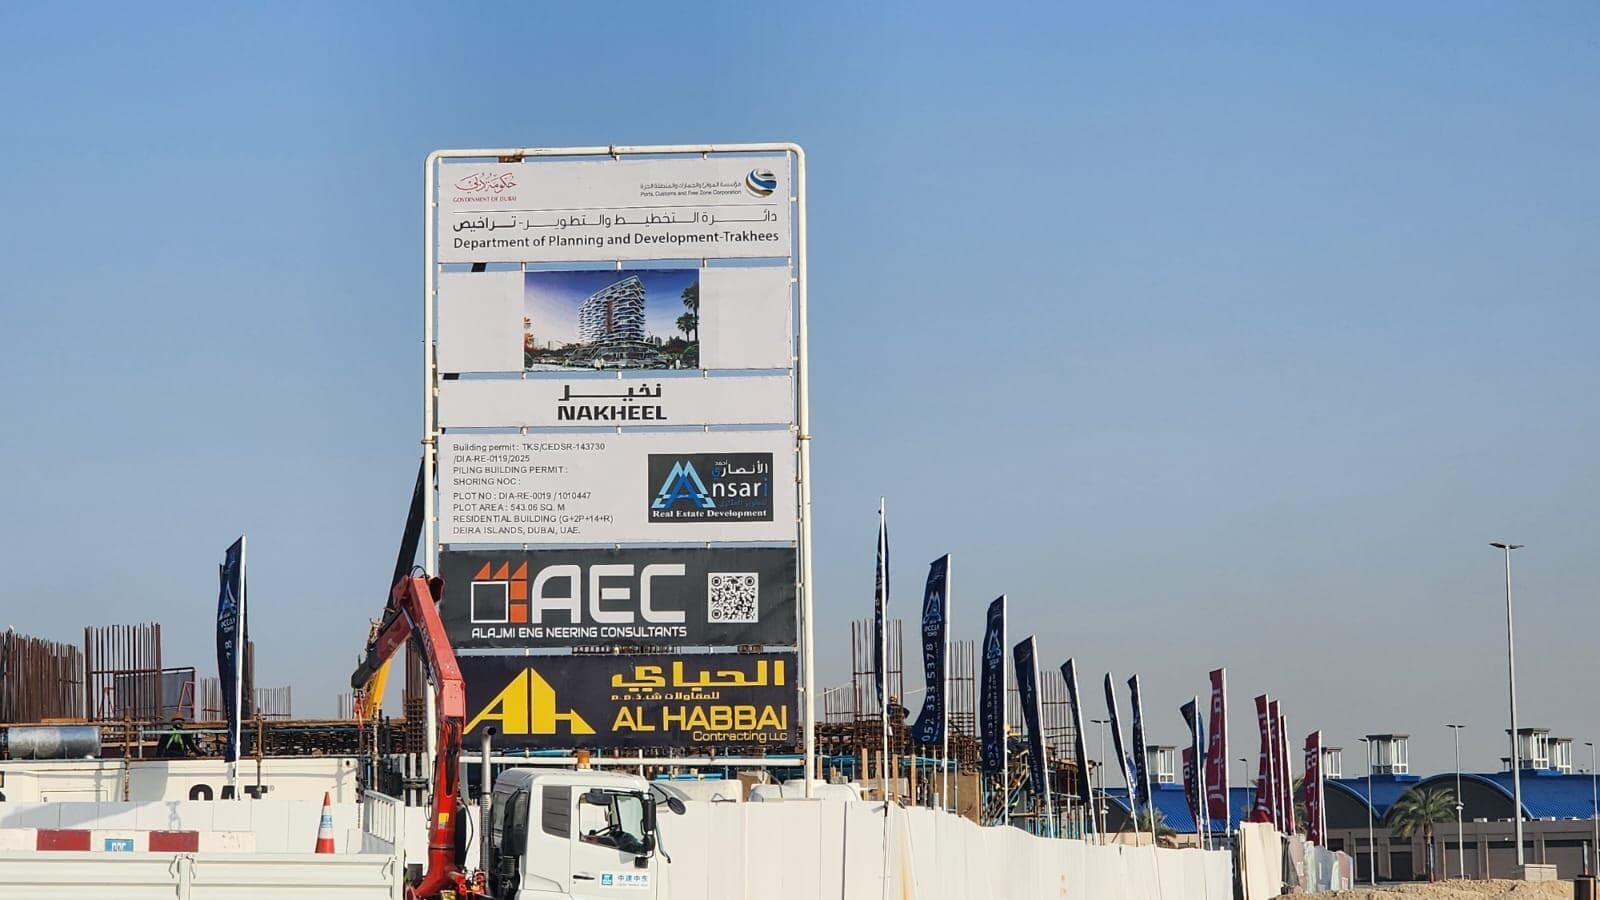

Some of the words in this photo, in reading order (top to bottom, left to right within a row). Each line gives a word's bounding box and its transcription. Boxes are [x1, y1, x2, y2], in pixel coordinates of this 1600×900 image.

[655, 190, 677, 198] Customs
[713, 188, 742, 197] Corporation
[454, 236, 530, 250] Department
[533, 235, 546, 247] of
[549, 234, 604, 248] Planning
[607, 233, 631, 245] and
[634, 230, 779, 246] Development-Trakhees
[558, 383, 661, 402] نخيل
[557, 405, 667, 420] NAKHEEL
[453, 443, 486, 453] Building
[522, 442, 606, 453] TKS/CEDSR-143730
[453, 454, 530, 464] /DIA-RE-0119/2025
[453, 466, 483, 474] PILING
[485, 466, 527, 474] BUILDING
[453, 478, 495, 486] SHORING
[453, 492, 476, 500] PLOT
[499, 492, 551, 500] DIA-RE-0019
[558, 492, 592, 500] 1010447
[453, 504, 476, 512] PLOT
[510, 503, 538, 512] 543.06
[557, 503, 565, 511] M
[453, 515, 512, 523] RESIDENTIAL
[514, 515, 557, 523] BUILDING
[559, 515, 614, 524] (G+2P+14+R)
[652, 510, 673, 518] Real
[676, 510, 705, 518] Estate
[707, 509, 767, 519] Development
[453, 527, 481, 535] DEIRA
[484, 527, 526, 535] ISLANDS,
[527, 527, 558, 535] DUBAI,
[531, 563, 686, 624] AEC
[471, 627, 515, 639] ALAJMI
[600, 626, 688, 638] CONSULTANTS
[925, 643, 936, 679] 5378
[926, 685, 936, 711] 333
[611, 705, 656, 732] AL
[662, 704, 788, 732] HABBAI
[921, 717, 935, 742] 052
[692, 730, 767, 744] Contracting
[768, 732, 788, 742] LLC
